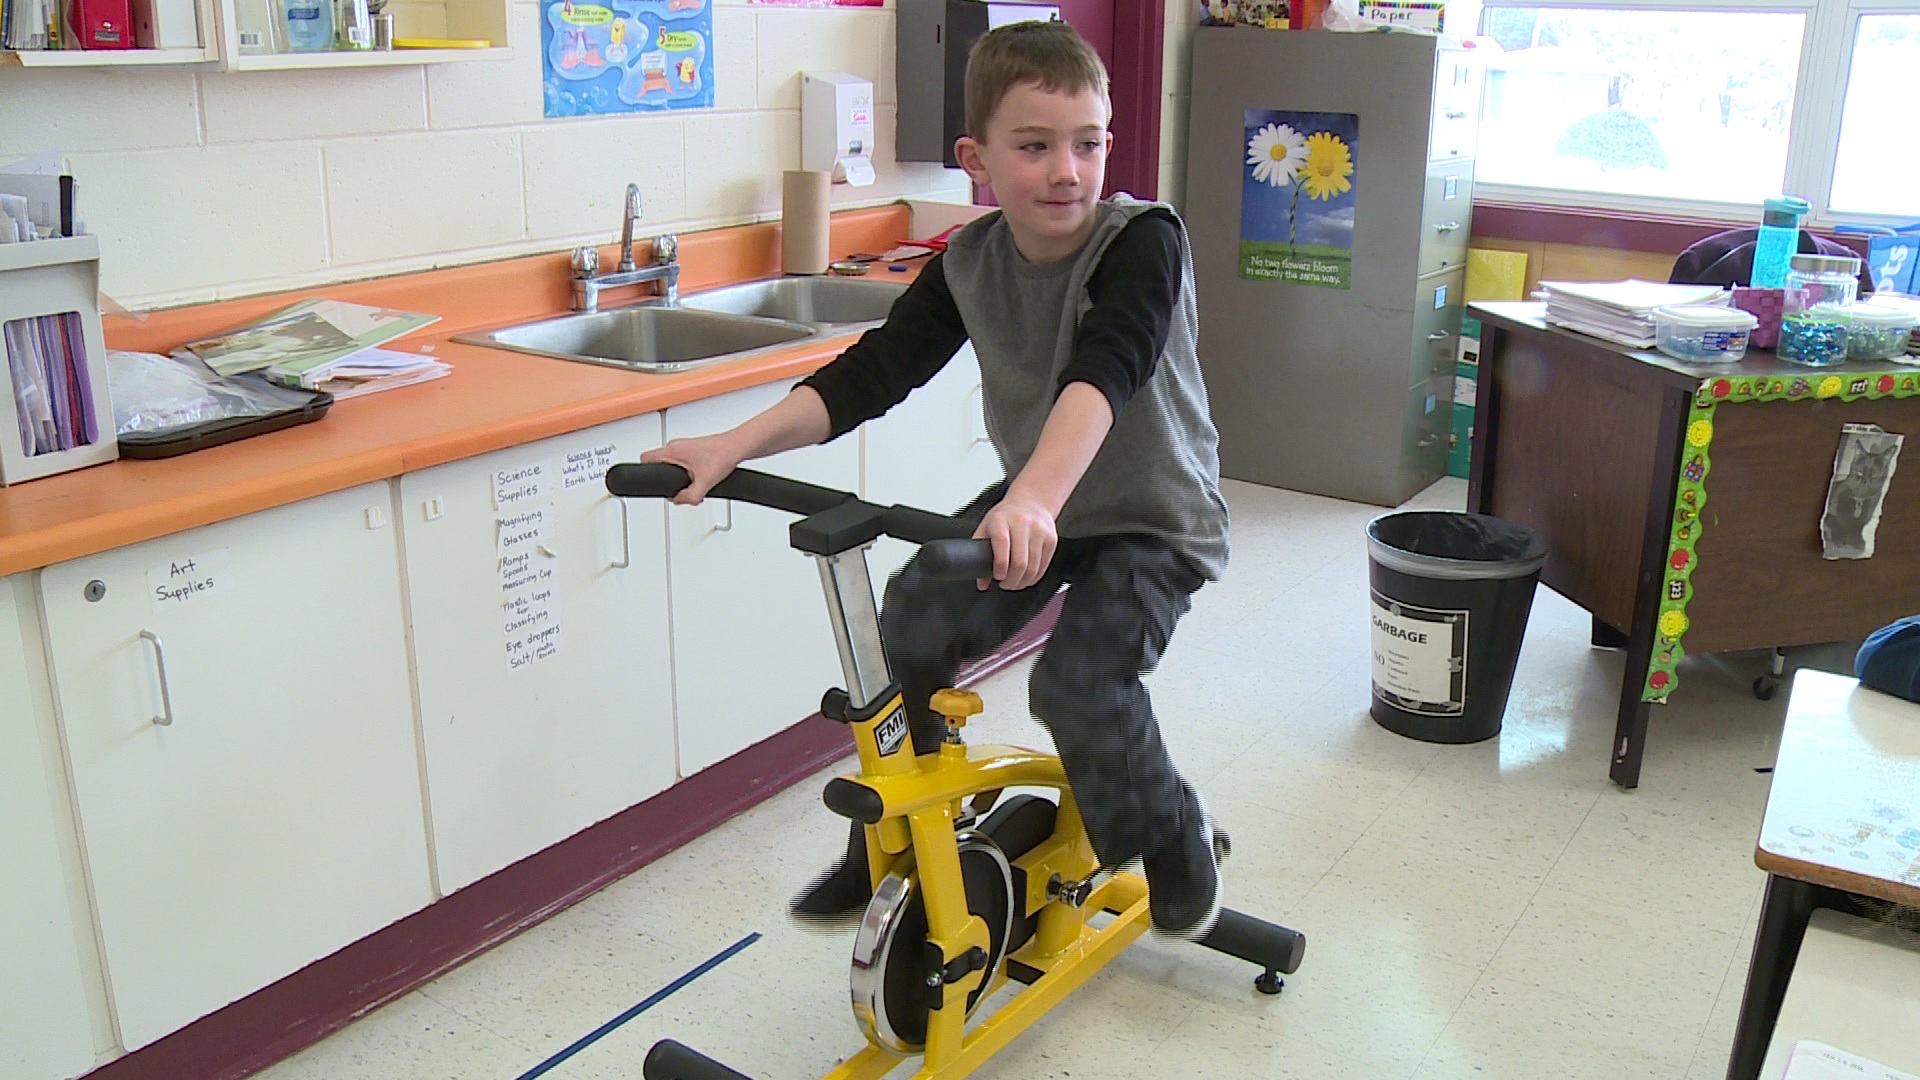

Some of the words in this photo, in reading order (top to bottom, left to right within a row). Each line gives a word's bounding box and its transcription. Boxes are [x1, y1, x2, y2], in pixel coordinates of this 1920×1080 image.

[574, 7, 590, 16] Rinse
[1371, 9, 1412, 24] Paper
[660, 27, 666, 45] 5
[667, 34, 677, 43] Dry
[1251, 256, 1263, 266] No
[1265, 258, 1280, 268] two
[1282, 258, 1311, 271] flowers
[1313, 261, 1339, 273] bloom
[1255, 268, 1284, 279] exactly
[1285, 270, 1298, 279] the
[1300, 273, 1320, 281] same
[1322, 274, 1340, 286] way.
[566, 450, 592, 464] Science
[497, 465, 541, 486] Science
[564, 475, 586, 488] Earth
[497, 485, 538, 503] Supplies
[499, 510, 542, 528] Magnifying
[503, 528, 538, 547] Glasses
[170, 559, 196, 578] Art
[502, 552, 528, 567] Ramps
[502, 562, 528, 580] Spoons
[539, 568, 552, 578] Cup
[156, 577, 214, 602] Supplies
[531, 590, 551, 602] loops
[516, 606, 529, 615] for
[505, 610, 548, 632] Classifying
[1373, 615, 1428, 644] GARBAGE
[505, 641, 522, 654] Eye
[527, 624, 560, 644] droppers
[879, 712, 903, 744] FMI
